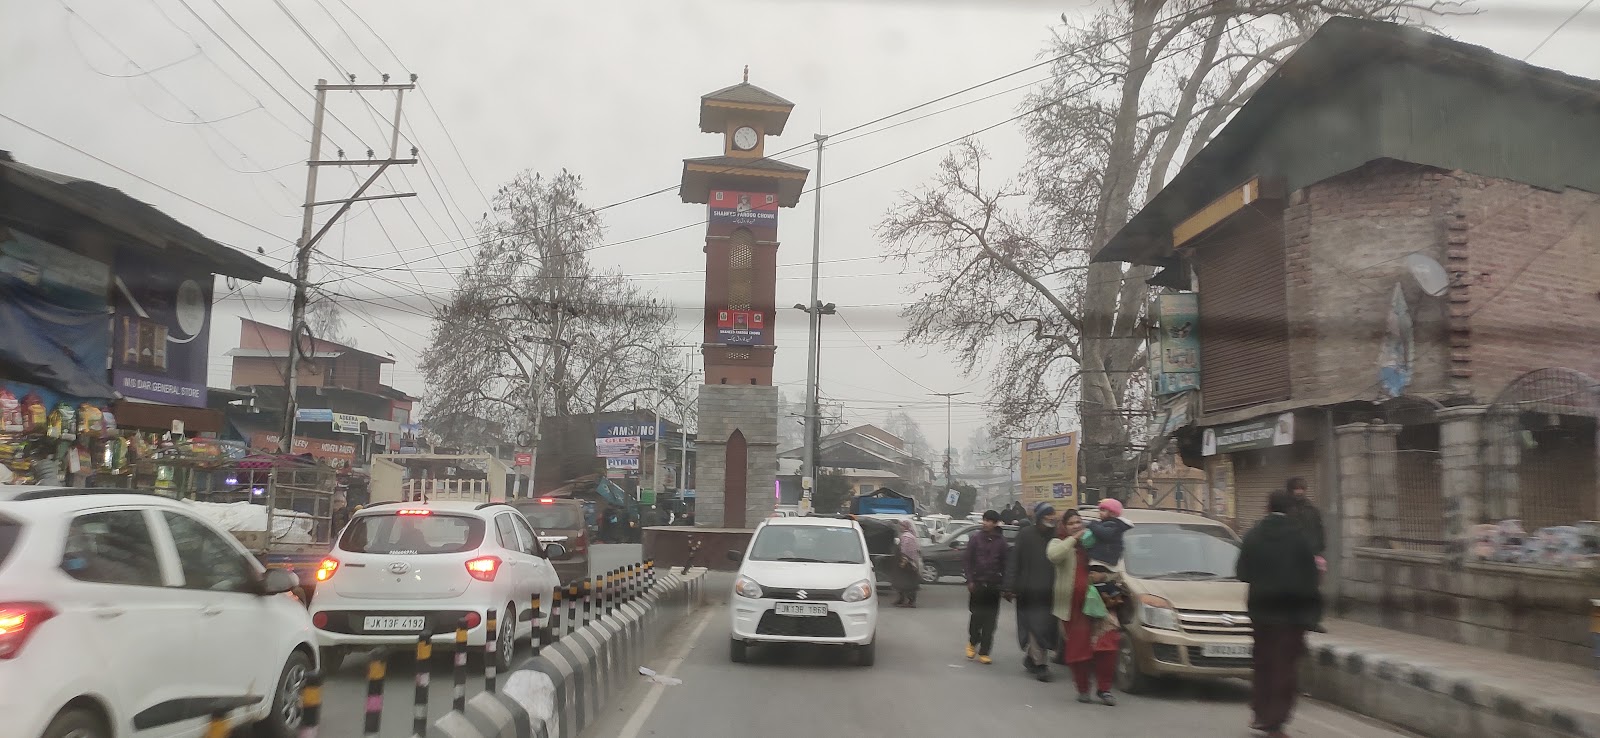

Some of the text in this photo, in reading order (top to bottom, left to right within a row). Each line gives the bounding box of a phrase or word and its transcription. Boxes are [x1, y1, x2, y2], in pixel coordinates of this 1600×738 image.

[137, 379, 152, 390] DAR
[152, 382, 181, 395] GENERAL
[181, 387, 200, 398] STORE
[607, 425, 655, 436] SAMSUNG
[608, 458, 638, 466] PITMAN
[370, 619, 424, 628] JK 13F 4192
